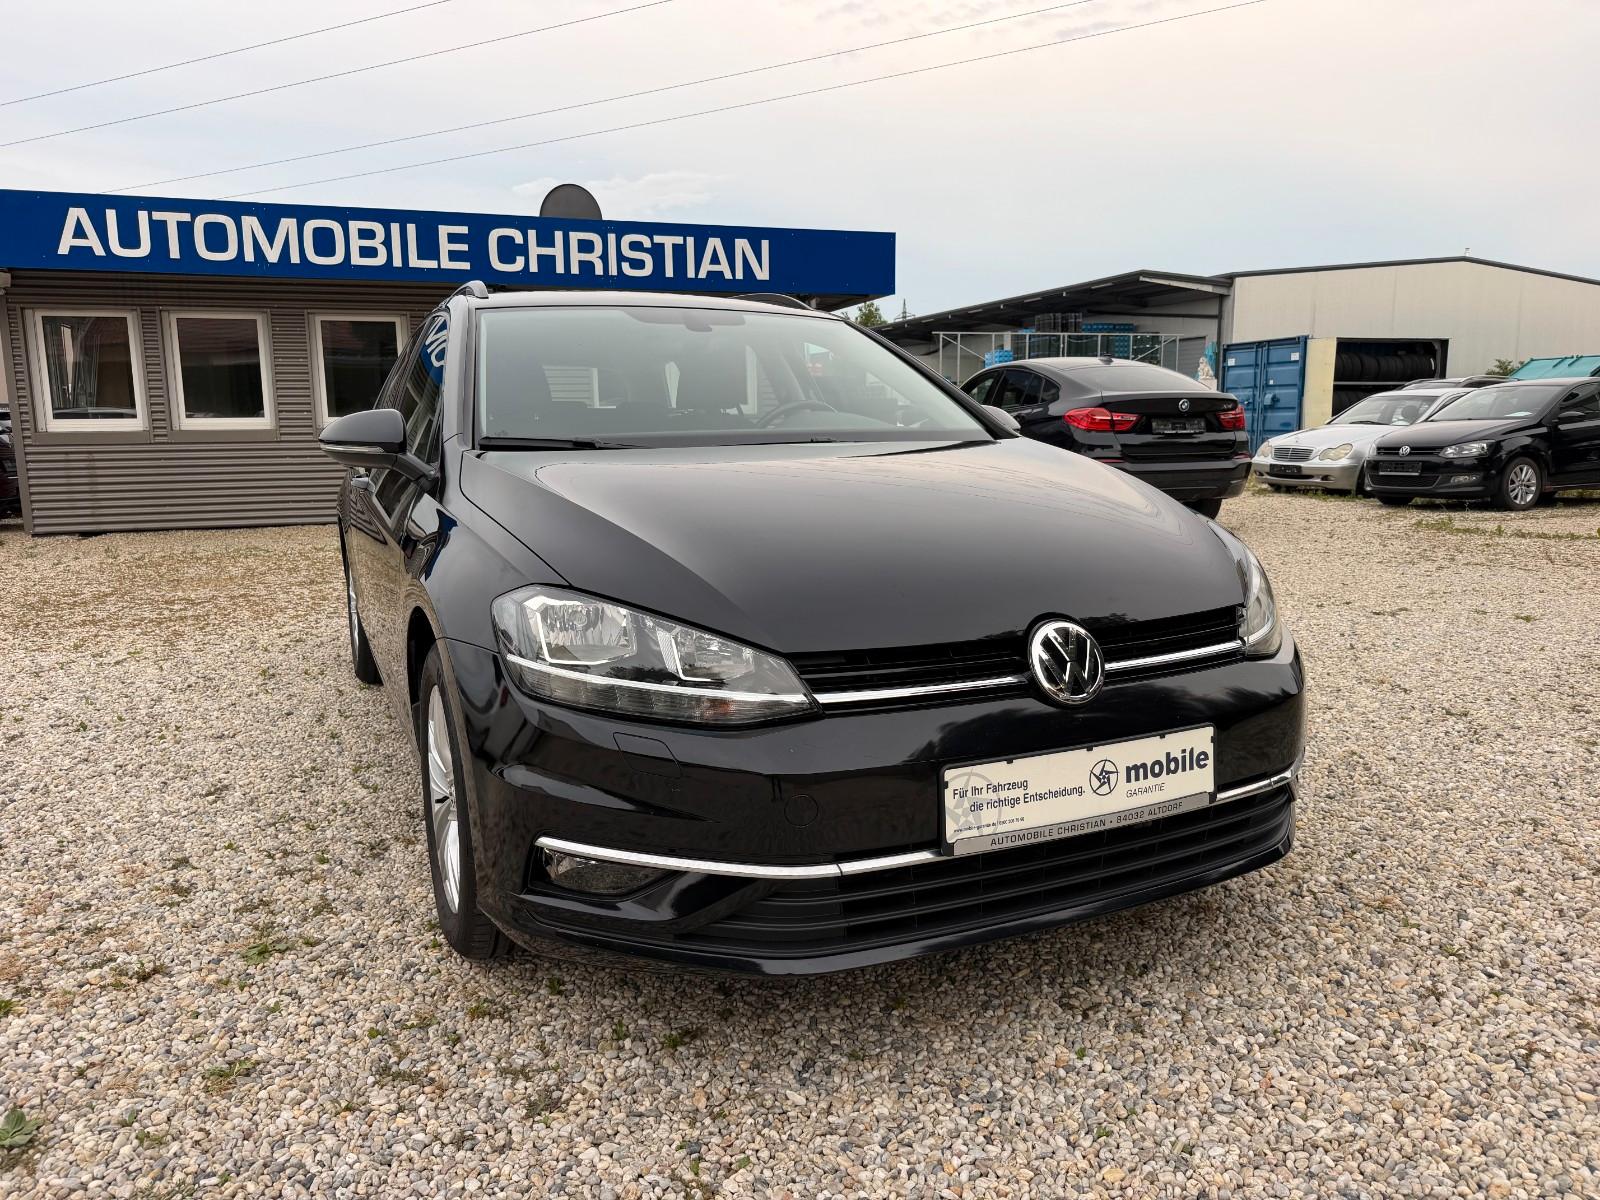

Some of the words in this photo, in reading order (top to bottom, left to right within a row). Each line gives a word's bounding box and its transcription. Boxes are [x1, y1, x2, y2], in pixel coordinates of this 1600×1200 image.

[57, 206, 471, 270] AUTOMOBILE
[488, 227, 770, 281] CHRISTIAN
[1030, 621, 1105, 704] VW
[1125, 747, 1209, 783] mobile
[953, 788, 969, 799] Für
[971, 785, 984, 797] Ihr
[986, 779, 1028, 794] Fahrzeug
[969, 801, 984, 813] die
[986, 796, 1021, 810] richtige
[1023, 785, 1086, 804] Entscheidung.
[1126, 783, 1166, 798] GARANTIE
[990, 829, 1053, 846] AUTOMOBILE
[1057, 820, 1106, 835] CHRISTIAN
[1116, 811, 1145, 823] 84032
[1148, 801, 1183, 817] ALTDORF
